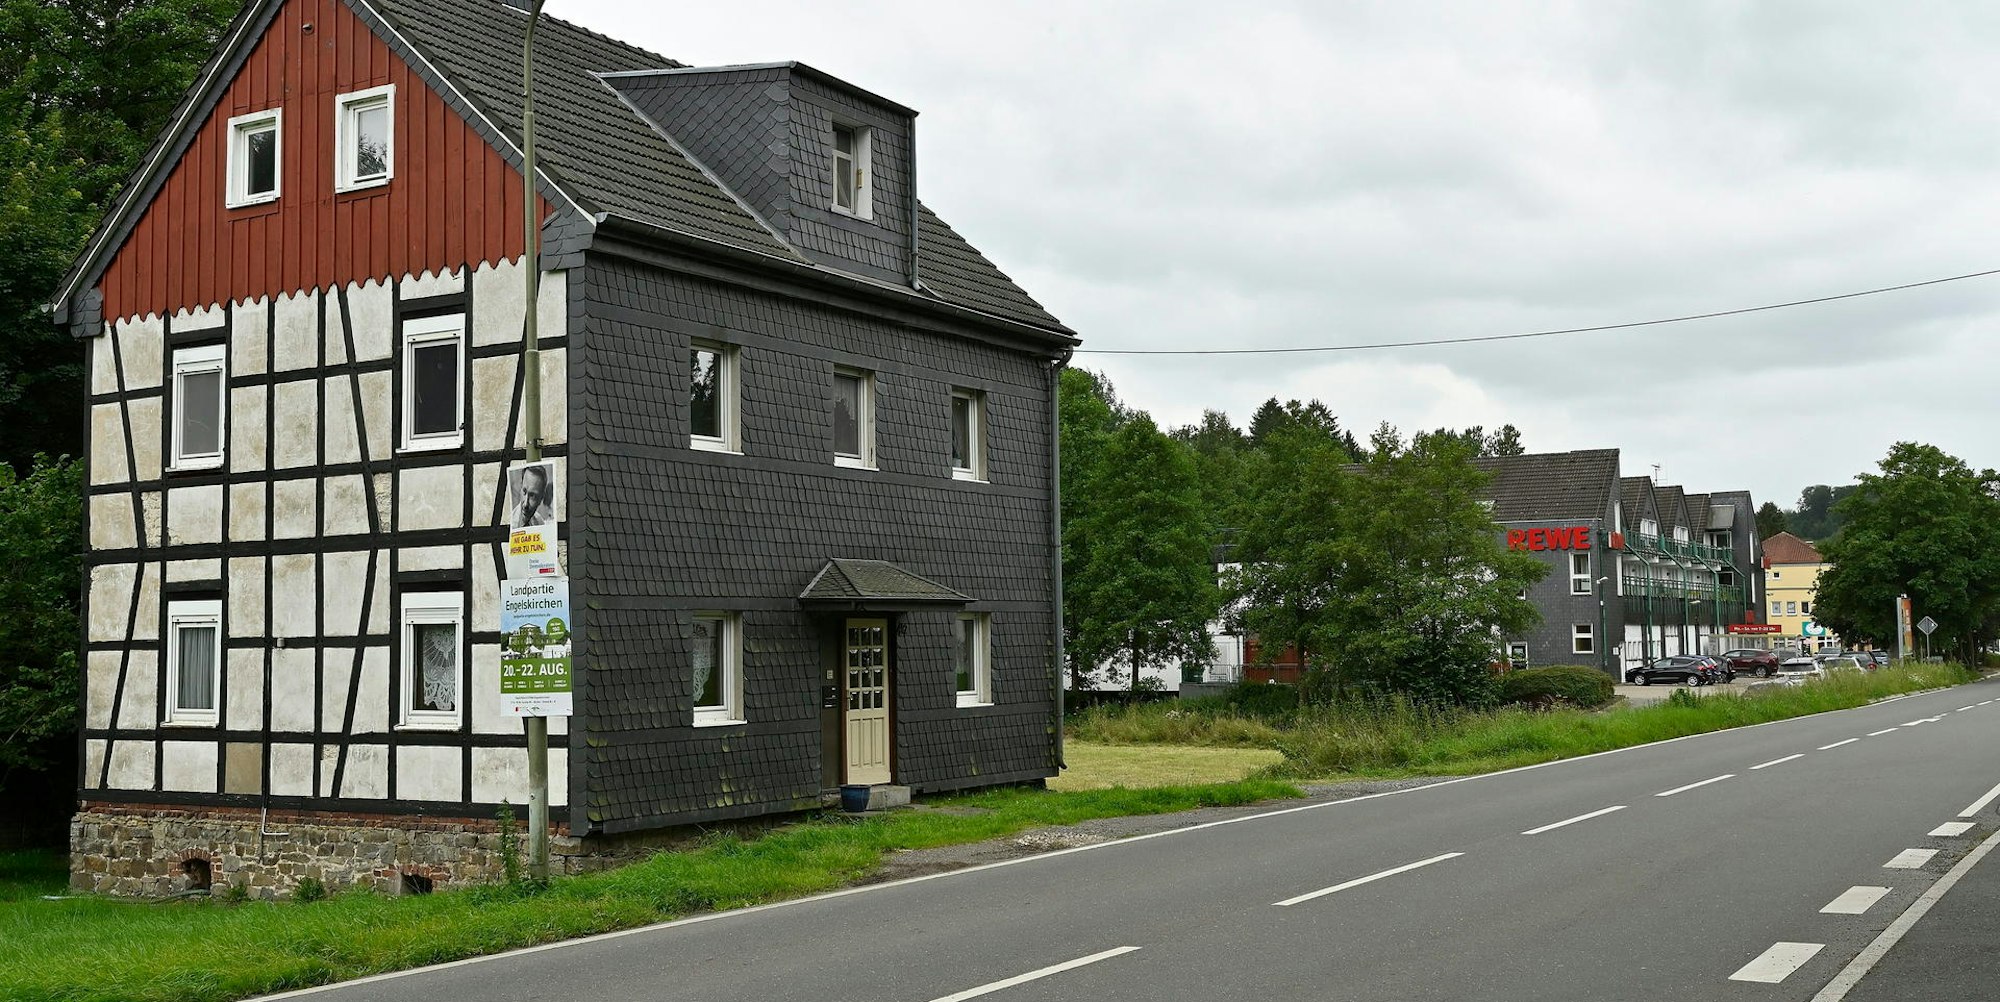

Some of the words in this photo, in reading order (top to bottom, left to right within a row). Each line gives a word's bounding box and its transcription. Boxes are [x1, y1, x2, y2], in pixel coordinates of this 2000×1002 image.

[521, 535, 532, 543] GAB
[1507, 526, 1591, 551] REWE
[523, 545, 529, 553] ZU
[530, 544, 545, 552] TUN.
[510, 583, 554, 597] Landpartie
[505, 598, 563, 613] Engelskirchen
[538, 663, 568, 676] AUG.
